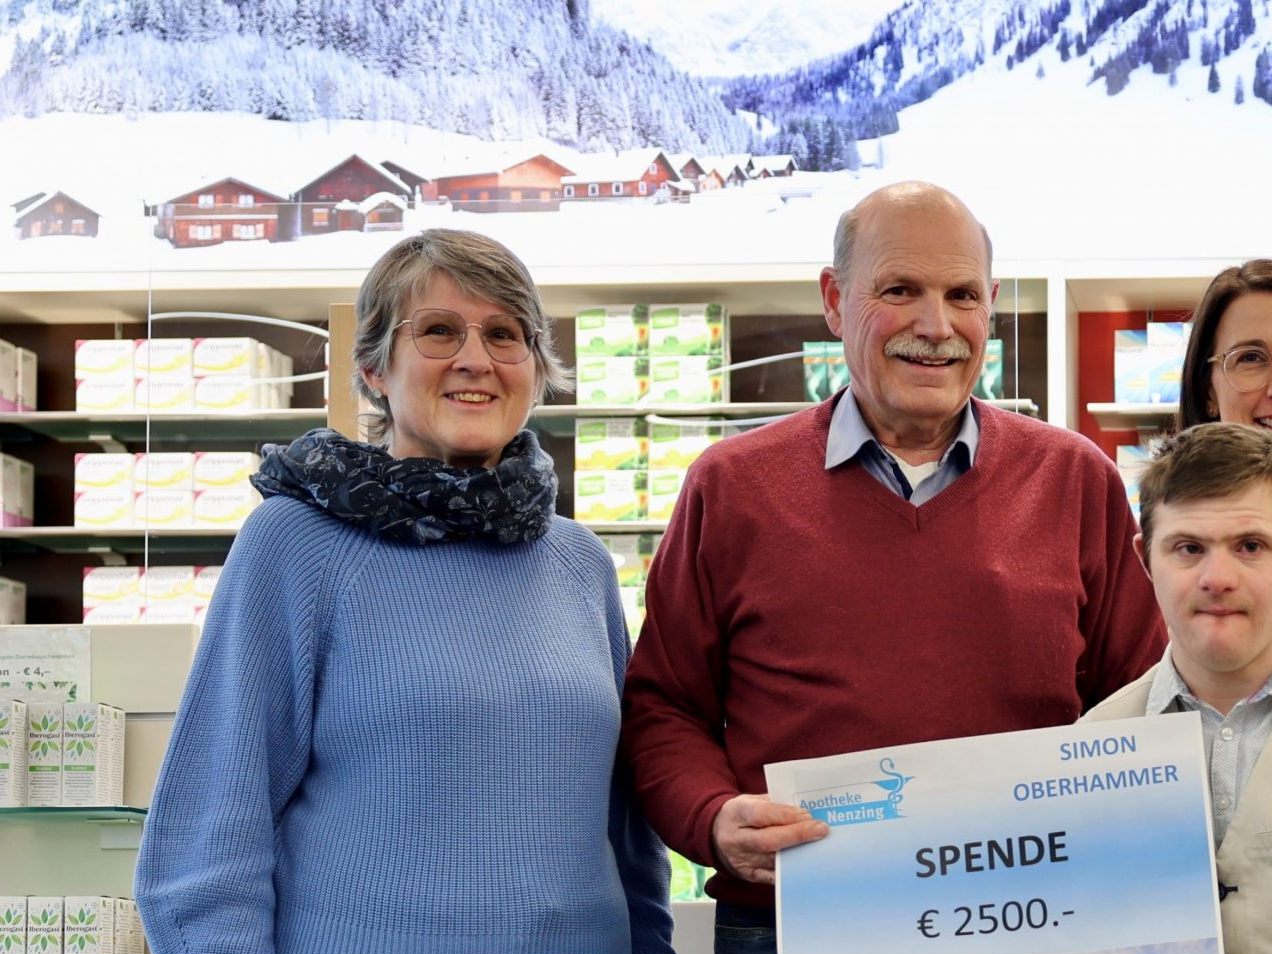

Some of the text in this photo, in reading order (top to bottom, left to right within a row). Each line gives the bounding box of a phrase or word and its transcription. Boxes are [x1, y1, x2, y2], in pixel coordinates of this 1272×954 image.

[24, 667, 30, 676] €
[65, 731, 96, 740] Iberogast
[1059, 735, 1137, 761] SIMON
[1013, 764, 1179, 802] OBERHAMMER
[800, 792, 862, 810] Apotheke
[827, 806, 884, 823] Nenzing
[915, 831, 1069, 878] SPENDE
[917, 898, 1075, 939] € 2500.-
[0, 926, 24, 934] erogast
[29, 926, 60, 934] Iberogast
[66, 925, 98, 934] Iberogast
